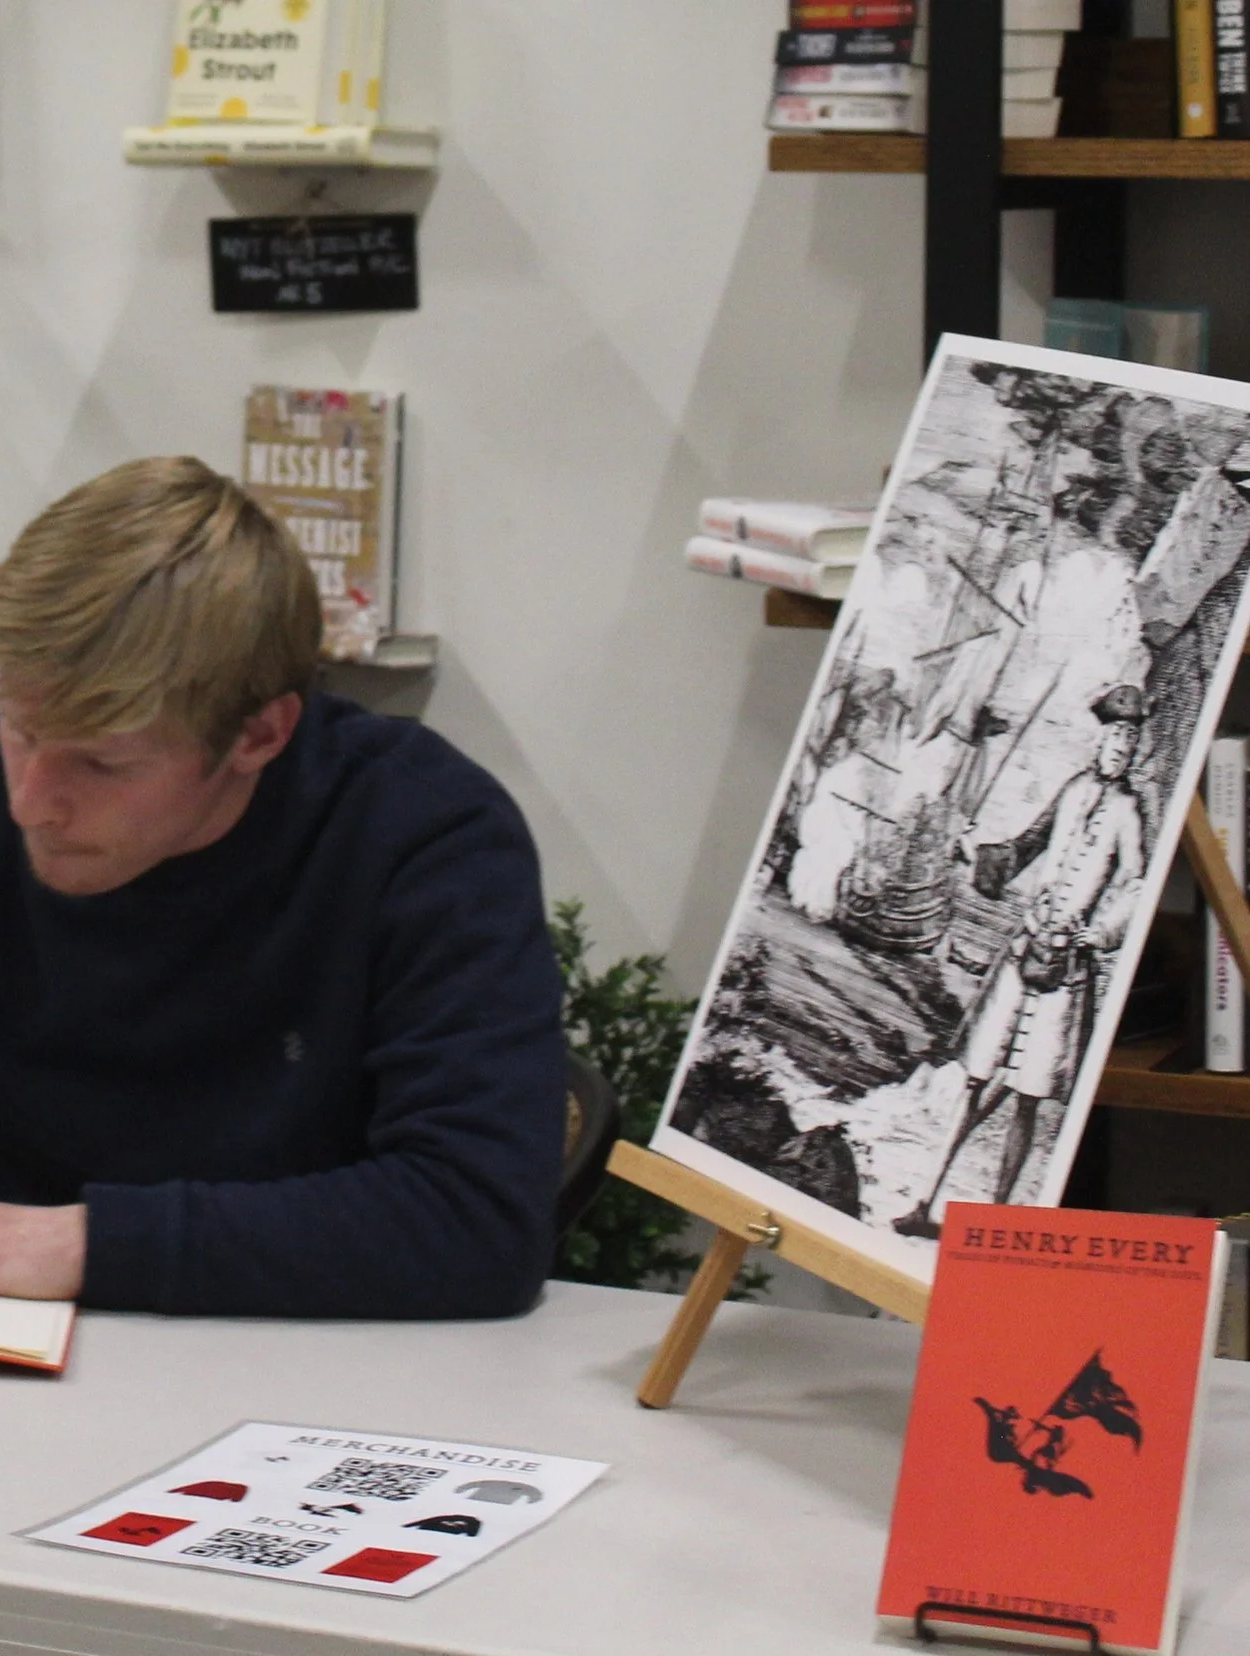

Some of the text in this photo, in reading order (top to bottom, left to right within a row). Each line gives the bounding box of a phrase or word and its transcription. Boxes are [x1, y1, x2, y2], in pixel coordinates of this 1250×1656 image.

[189, 27, 298, 50] Elizabeth
[201, 58, 276, 80] Strout
[249, 443, 372, 490] MESSAGE
[963, 1227, 1079, 1256] HENRY
[1086, 1236, 1195, 1265] EVERY
[291, 1434, 543, 1474] MERCHANDISE
[251, 1515, 351, 1537] BOOK
